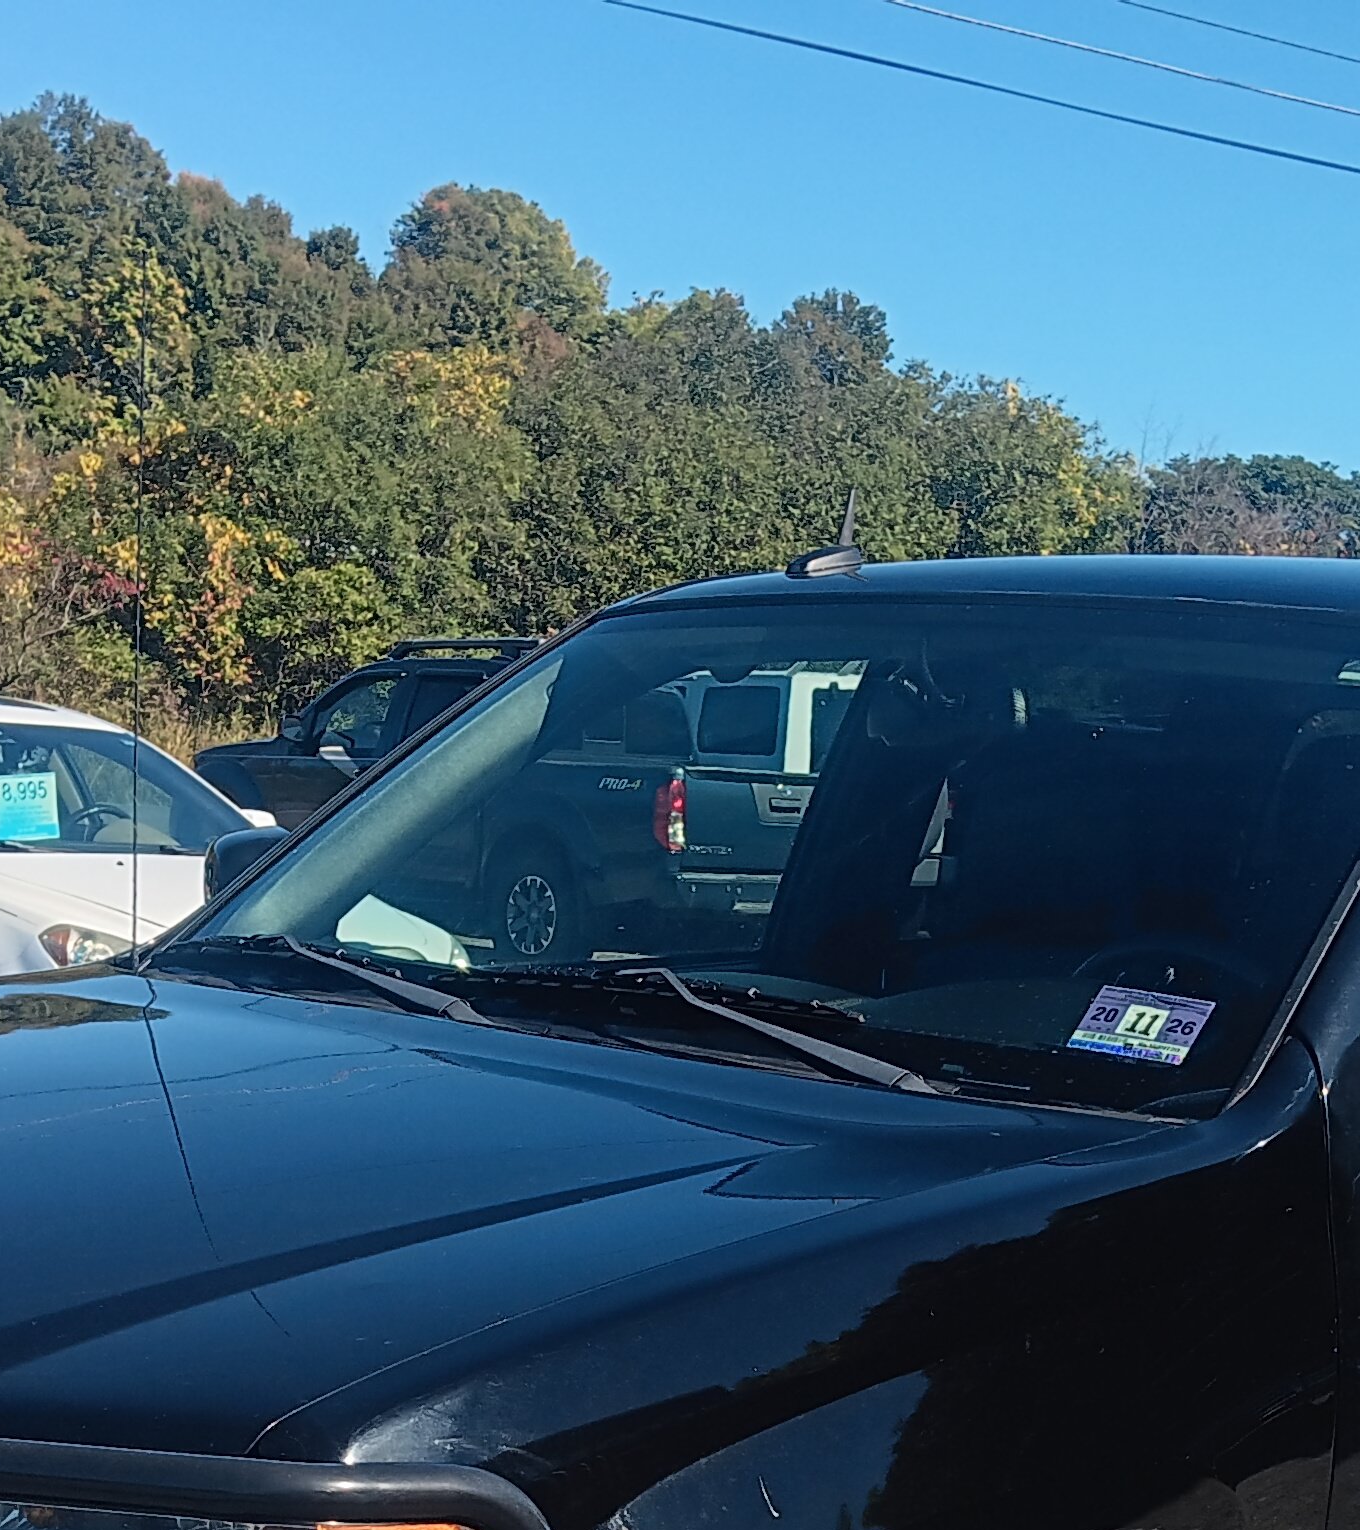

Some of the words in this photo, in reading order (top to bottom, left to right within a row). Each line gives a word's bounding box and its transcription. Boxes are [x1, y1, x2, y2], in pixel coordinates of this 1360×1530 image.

[1090, 1006, 1120, 1023] 20
[1124, 1011, 1160, 1037] 11
[1166, 1018, 1197, 1036] 26
